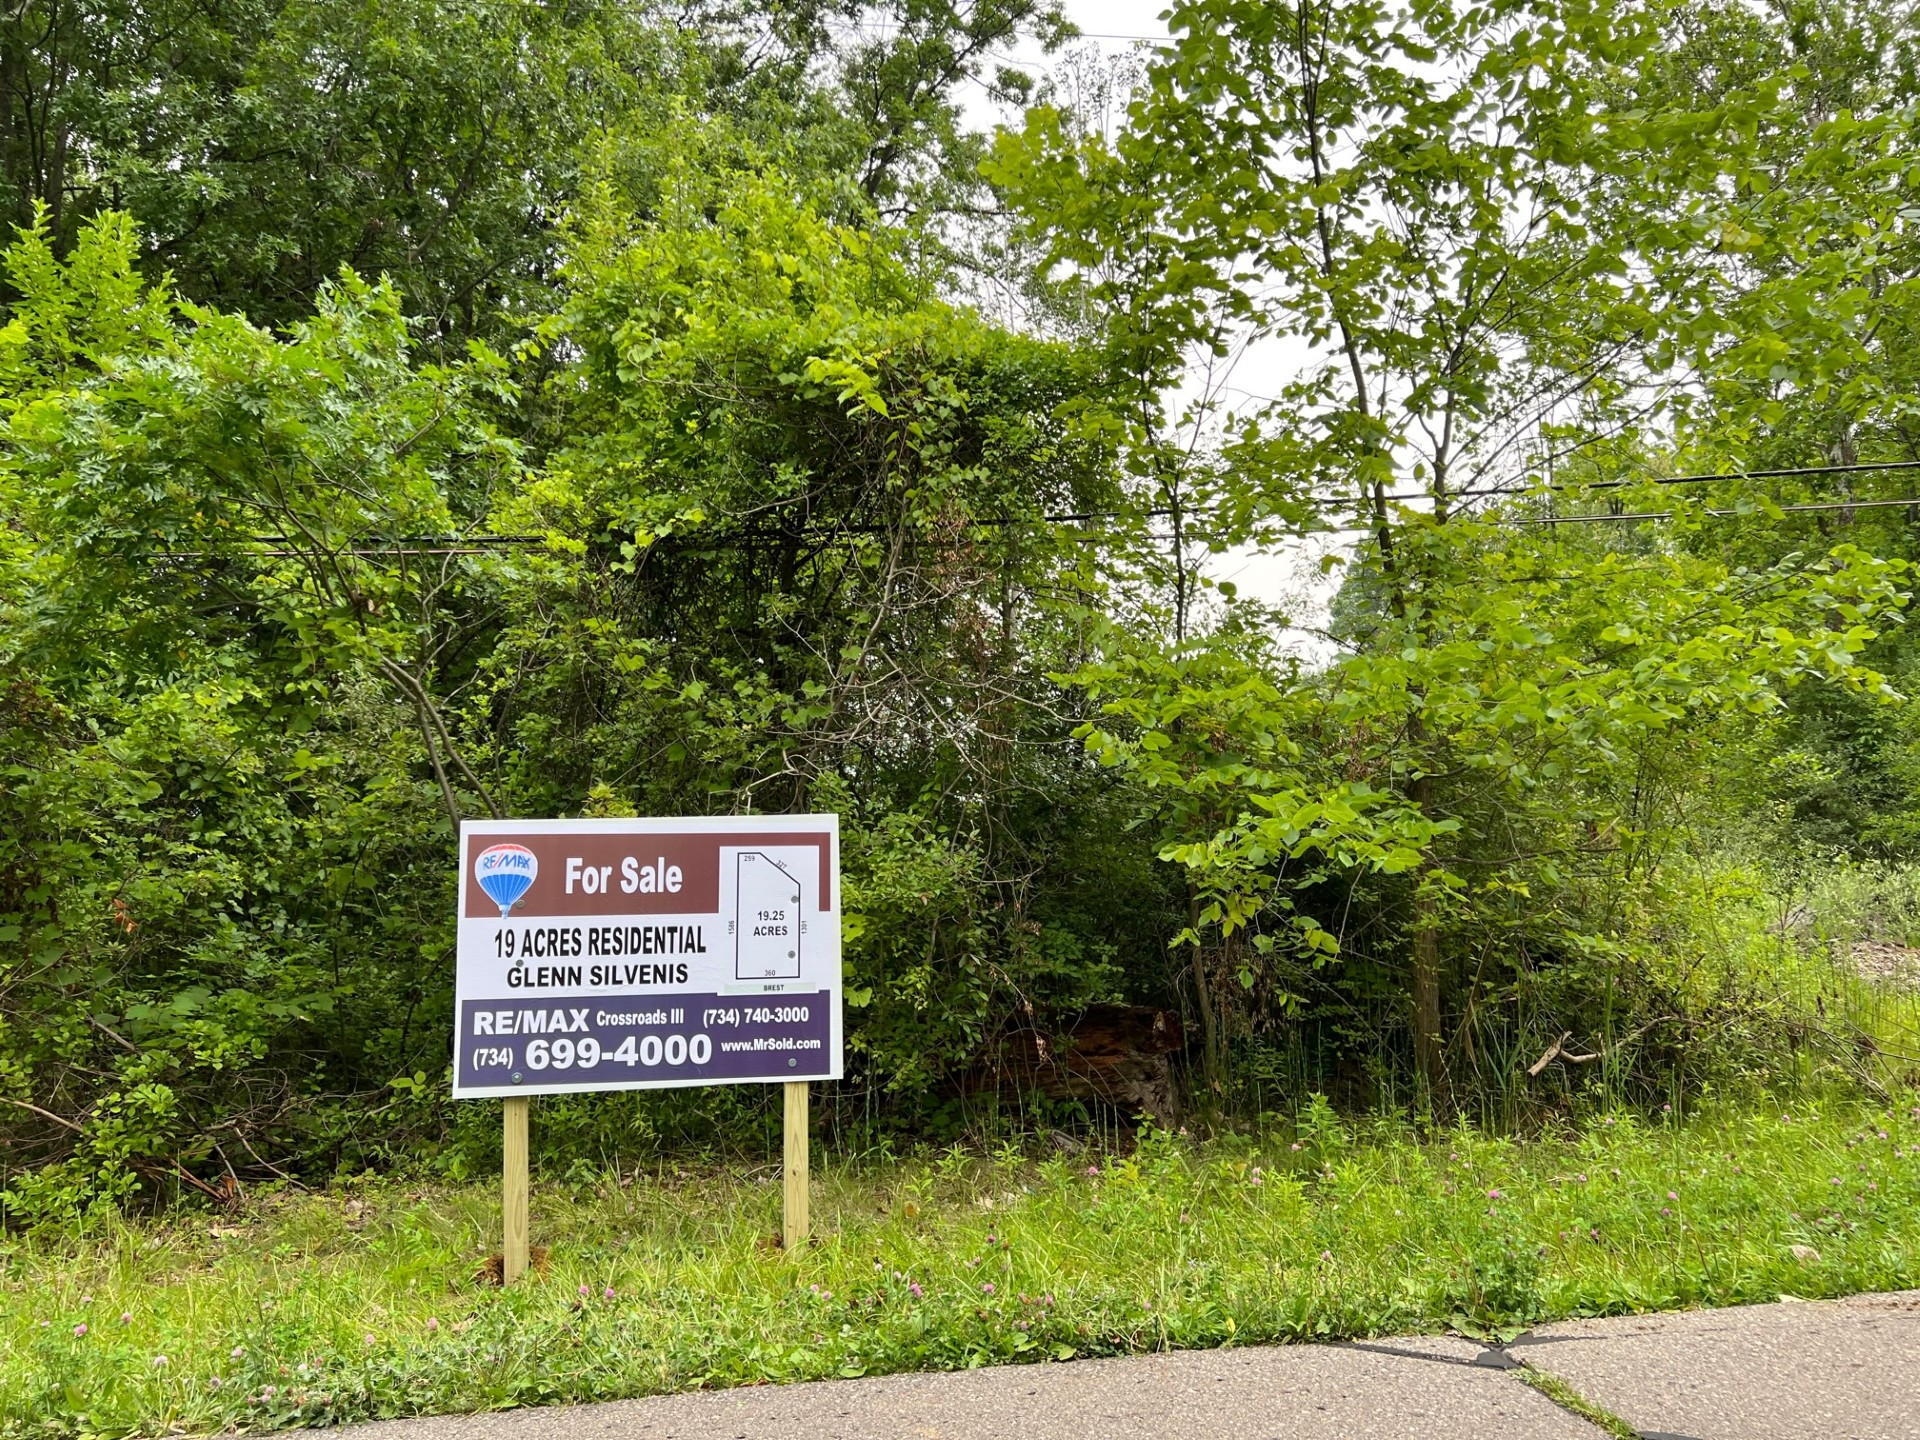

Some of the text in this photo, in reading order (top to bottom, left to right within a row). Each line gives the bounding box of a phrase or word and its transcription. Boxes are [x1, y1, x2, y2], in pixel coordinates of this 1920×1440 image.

[483, 853, 530, 871] RE/MAX
[565, 856, 683, 894] For Sale
[757, 911, 784, 922] 19.25
[494, 925, 706, 957] 19 ACRES RESIDENTIAL
[753, 925, 788, 936] ACRES
[507, 963, 688, 988] GLENN SILVENIS
[473, 1009, 684, 1035] RE/MAX Crossroads III
[703, 1007, 809, 1027] (734) 740-3000
[473, 1034, 712, 1071] (734) 699-4000
[721, 1038, 821, 1053] www.MrSold.com
